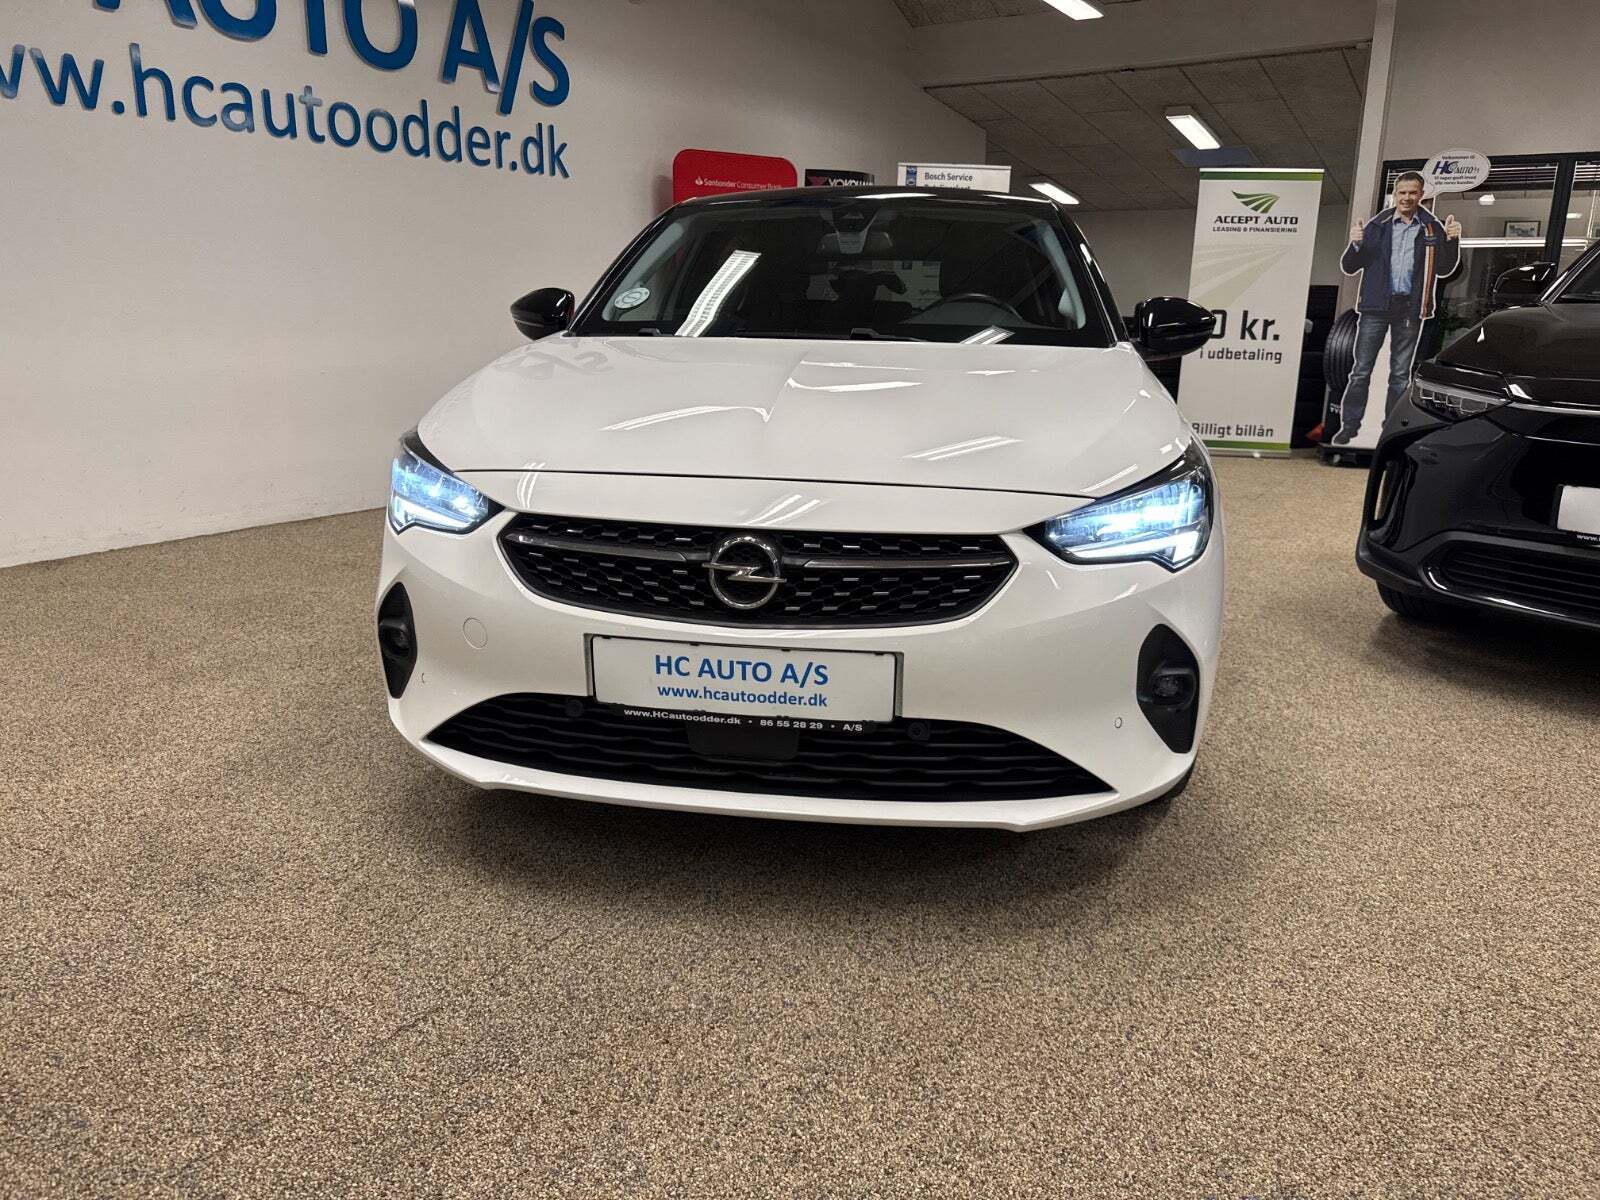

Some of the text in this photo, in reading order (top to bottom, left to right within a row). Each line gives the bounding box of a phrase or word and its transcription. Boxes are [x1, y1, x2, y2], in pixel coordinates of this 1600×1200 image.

[439, 0, 570, 115] A/S
[703, 178, 737, 188] Santander
[924, 172, 973, 181] Bosch Service
[1214, 215, 1299, 225] ACCEPT AUTO
[1240, 310, 1280, 341] kr.
[1207, 347, 1283, 365] udbetaling
[1235, 423, 1274, 437] billån
[655, 654, 829, 689] HC AUTO A/S
[657, 686, 828, 707] www.hcautoodder.dk
[623, 709, 863, 732] www.HCautoodder.dk 86 55 28 29 A/S
